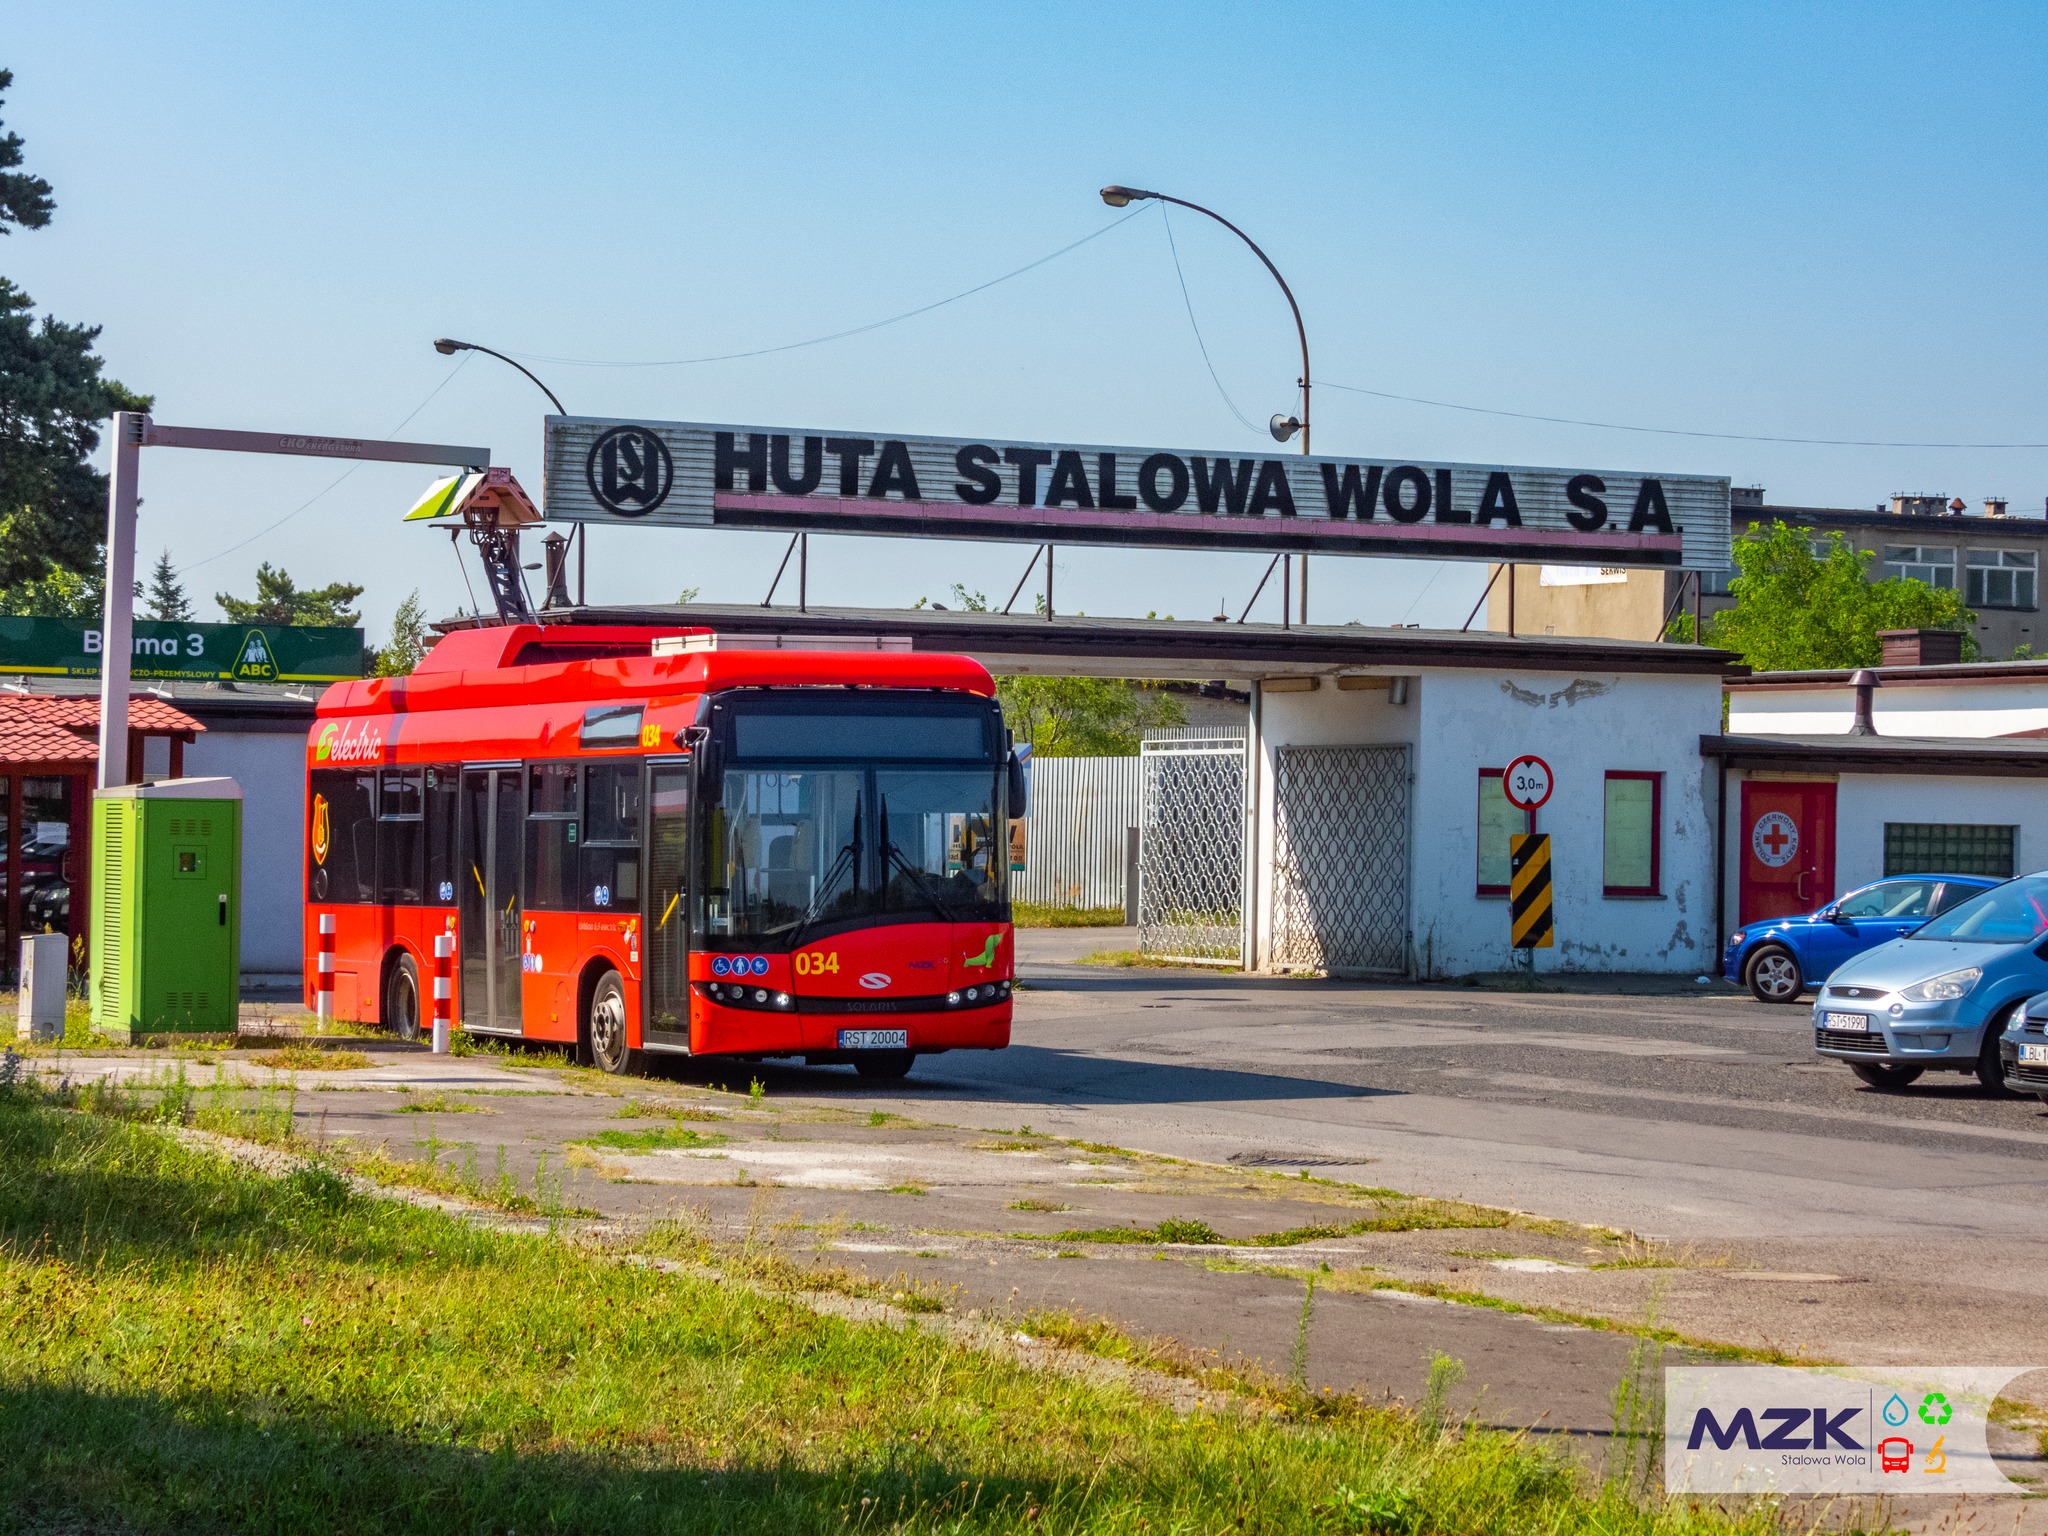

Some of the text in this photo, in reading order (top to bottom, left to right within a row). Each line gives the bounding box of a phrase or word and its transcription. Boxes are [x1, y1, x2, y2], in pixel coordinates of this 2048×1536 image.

[715, 431, 1684, 533] HUTA STALOWA WOLA S.A.
[84, 630, 204, 656] Bma 3
[71, 667, 97, 675] SKLEP
[239, 664, 271, 677] ABC
[331, 720, 382, 761] electric
[642, 724, 660, 747] 034
[1758, 814, 1797, 834] CZERWONY
[795, 952, 840, 975] 034
[1828, 1015, 1866, 1029] RST 51990
[845, 1032, 867, 1044] RST
[870, 1032, 906, 1044] 20004
[2025, 1046, 2039, 1060] LBL
